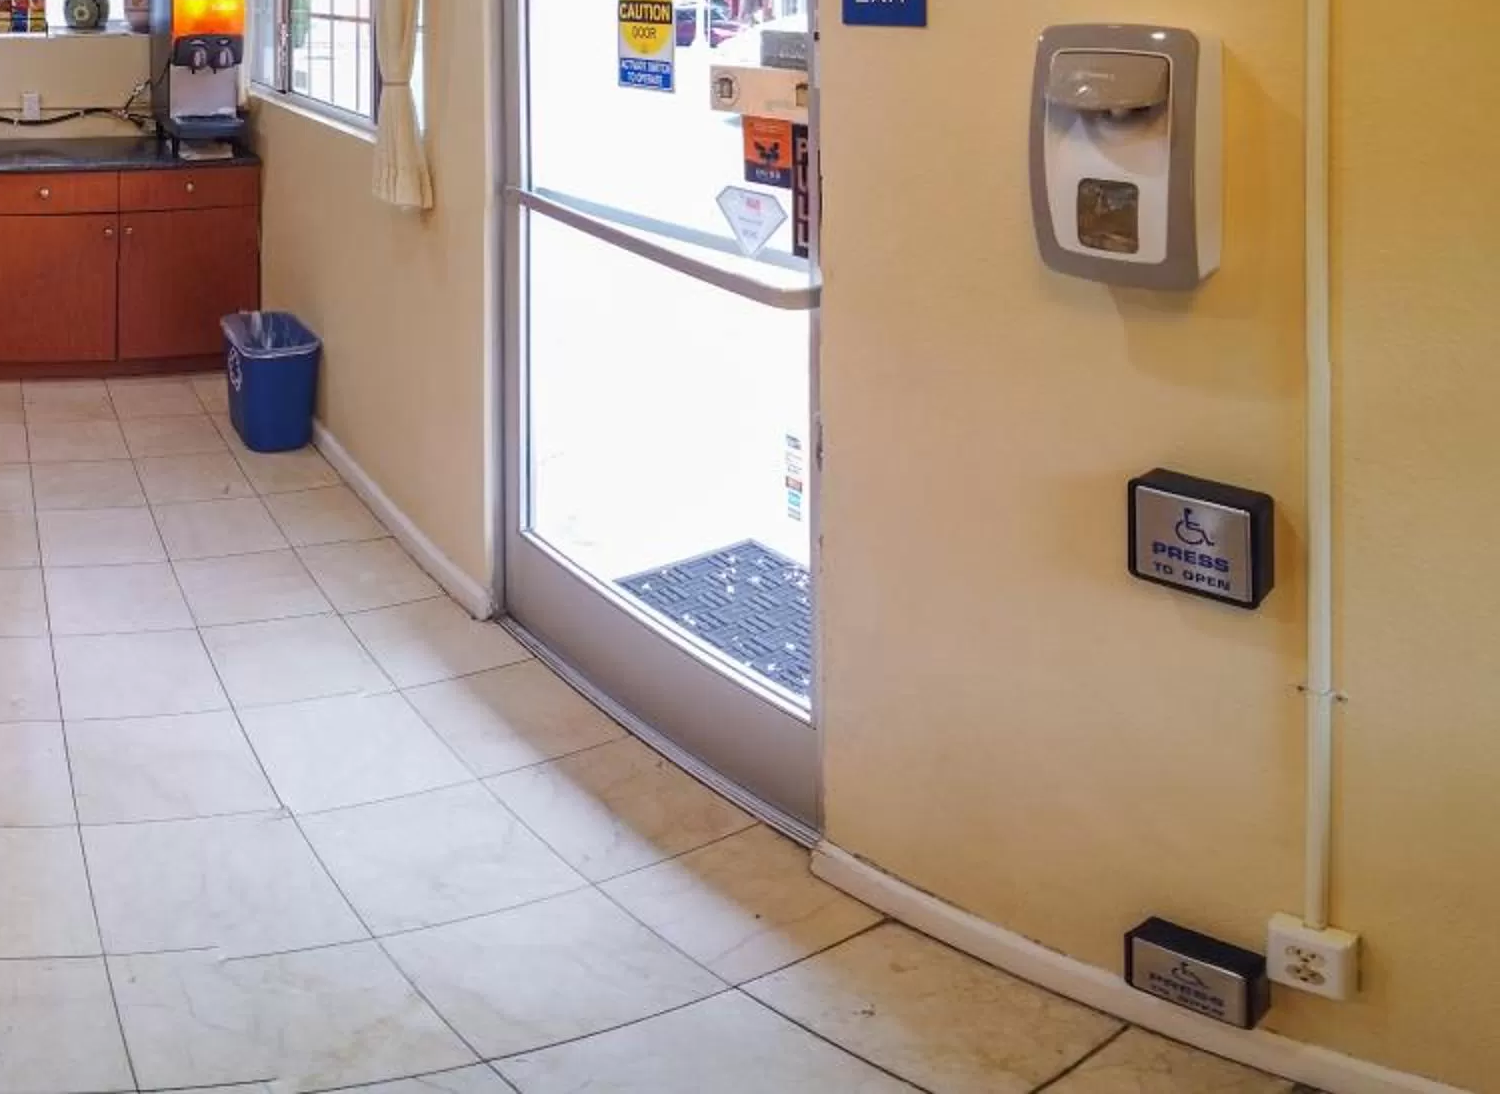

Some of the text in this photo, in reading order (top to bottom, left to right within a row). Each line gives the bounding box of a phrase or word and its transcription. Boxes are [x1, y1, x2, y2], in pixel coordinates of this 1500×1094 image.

[620, 2, 670, 21] CAUTION
[632, 27, 657, 39] DOOR
[1152, 541, 1229, 573] PRESS
[1153, 562, 1230, 591] TO OPEN
